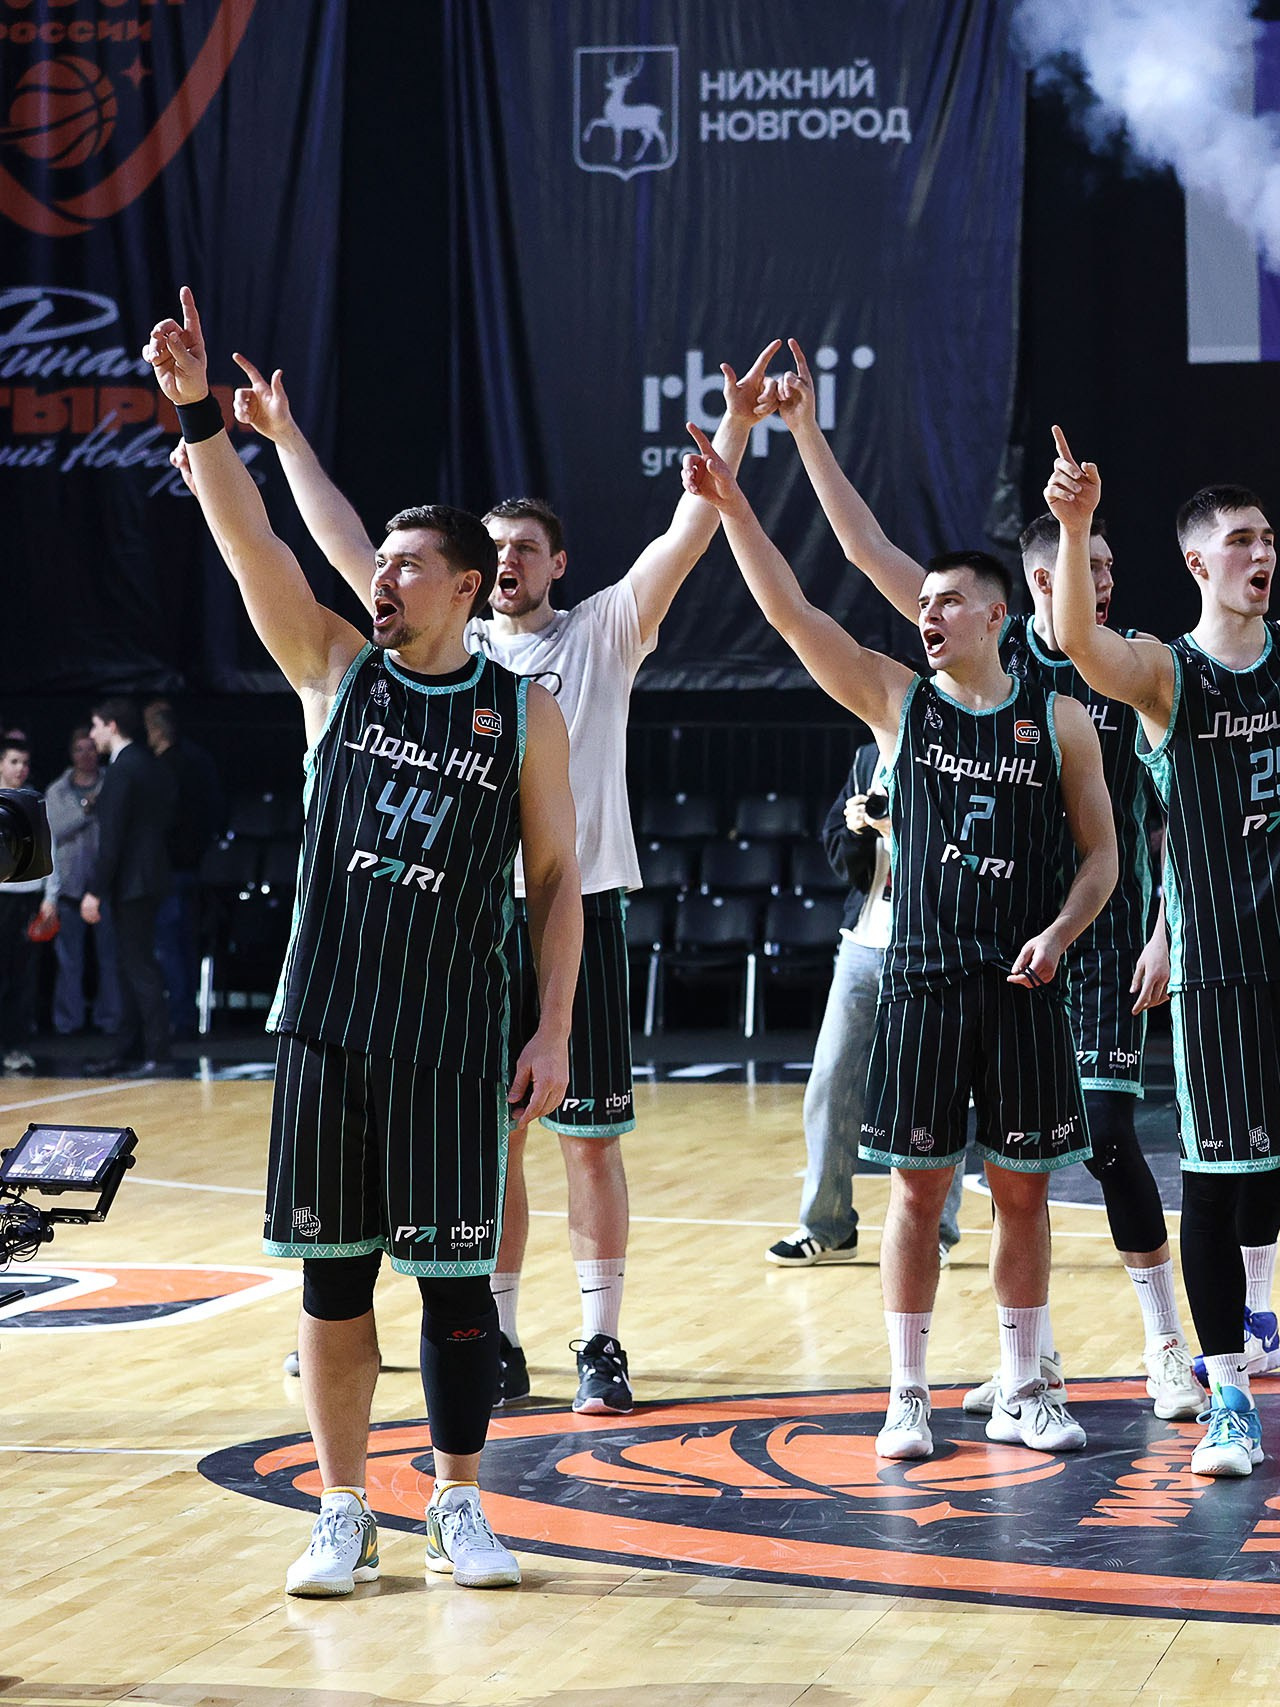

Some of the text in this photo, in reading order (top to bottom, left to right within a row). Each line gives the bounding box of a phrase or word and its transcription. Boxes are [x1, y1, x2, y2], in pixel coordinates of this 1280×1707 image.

[699, 57, 876, 101] НИЖНИЙ
[699, 106, 912, 144] НОВГОРОД
[375, 780, 454, 850] 44
[959, 794, 996, 841] 7
